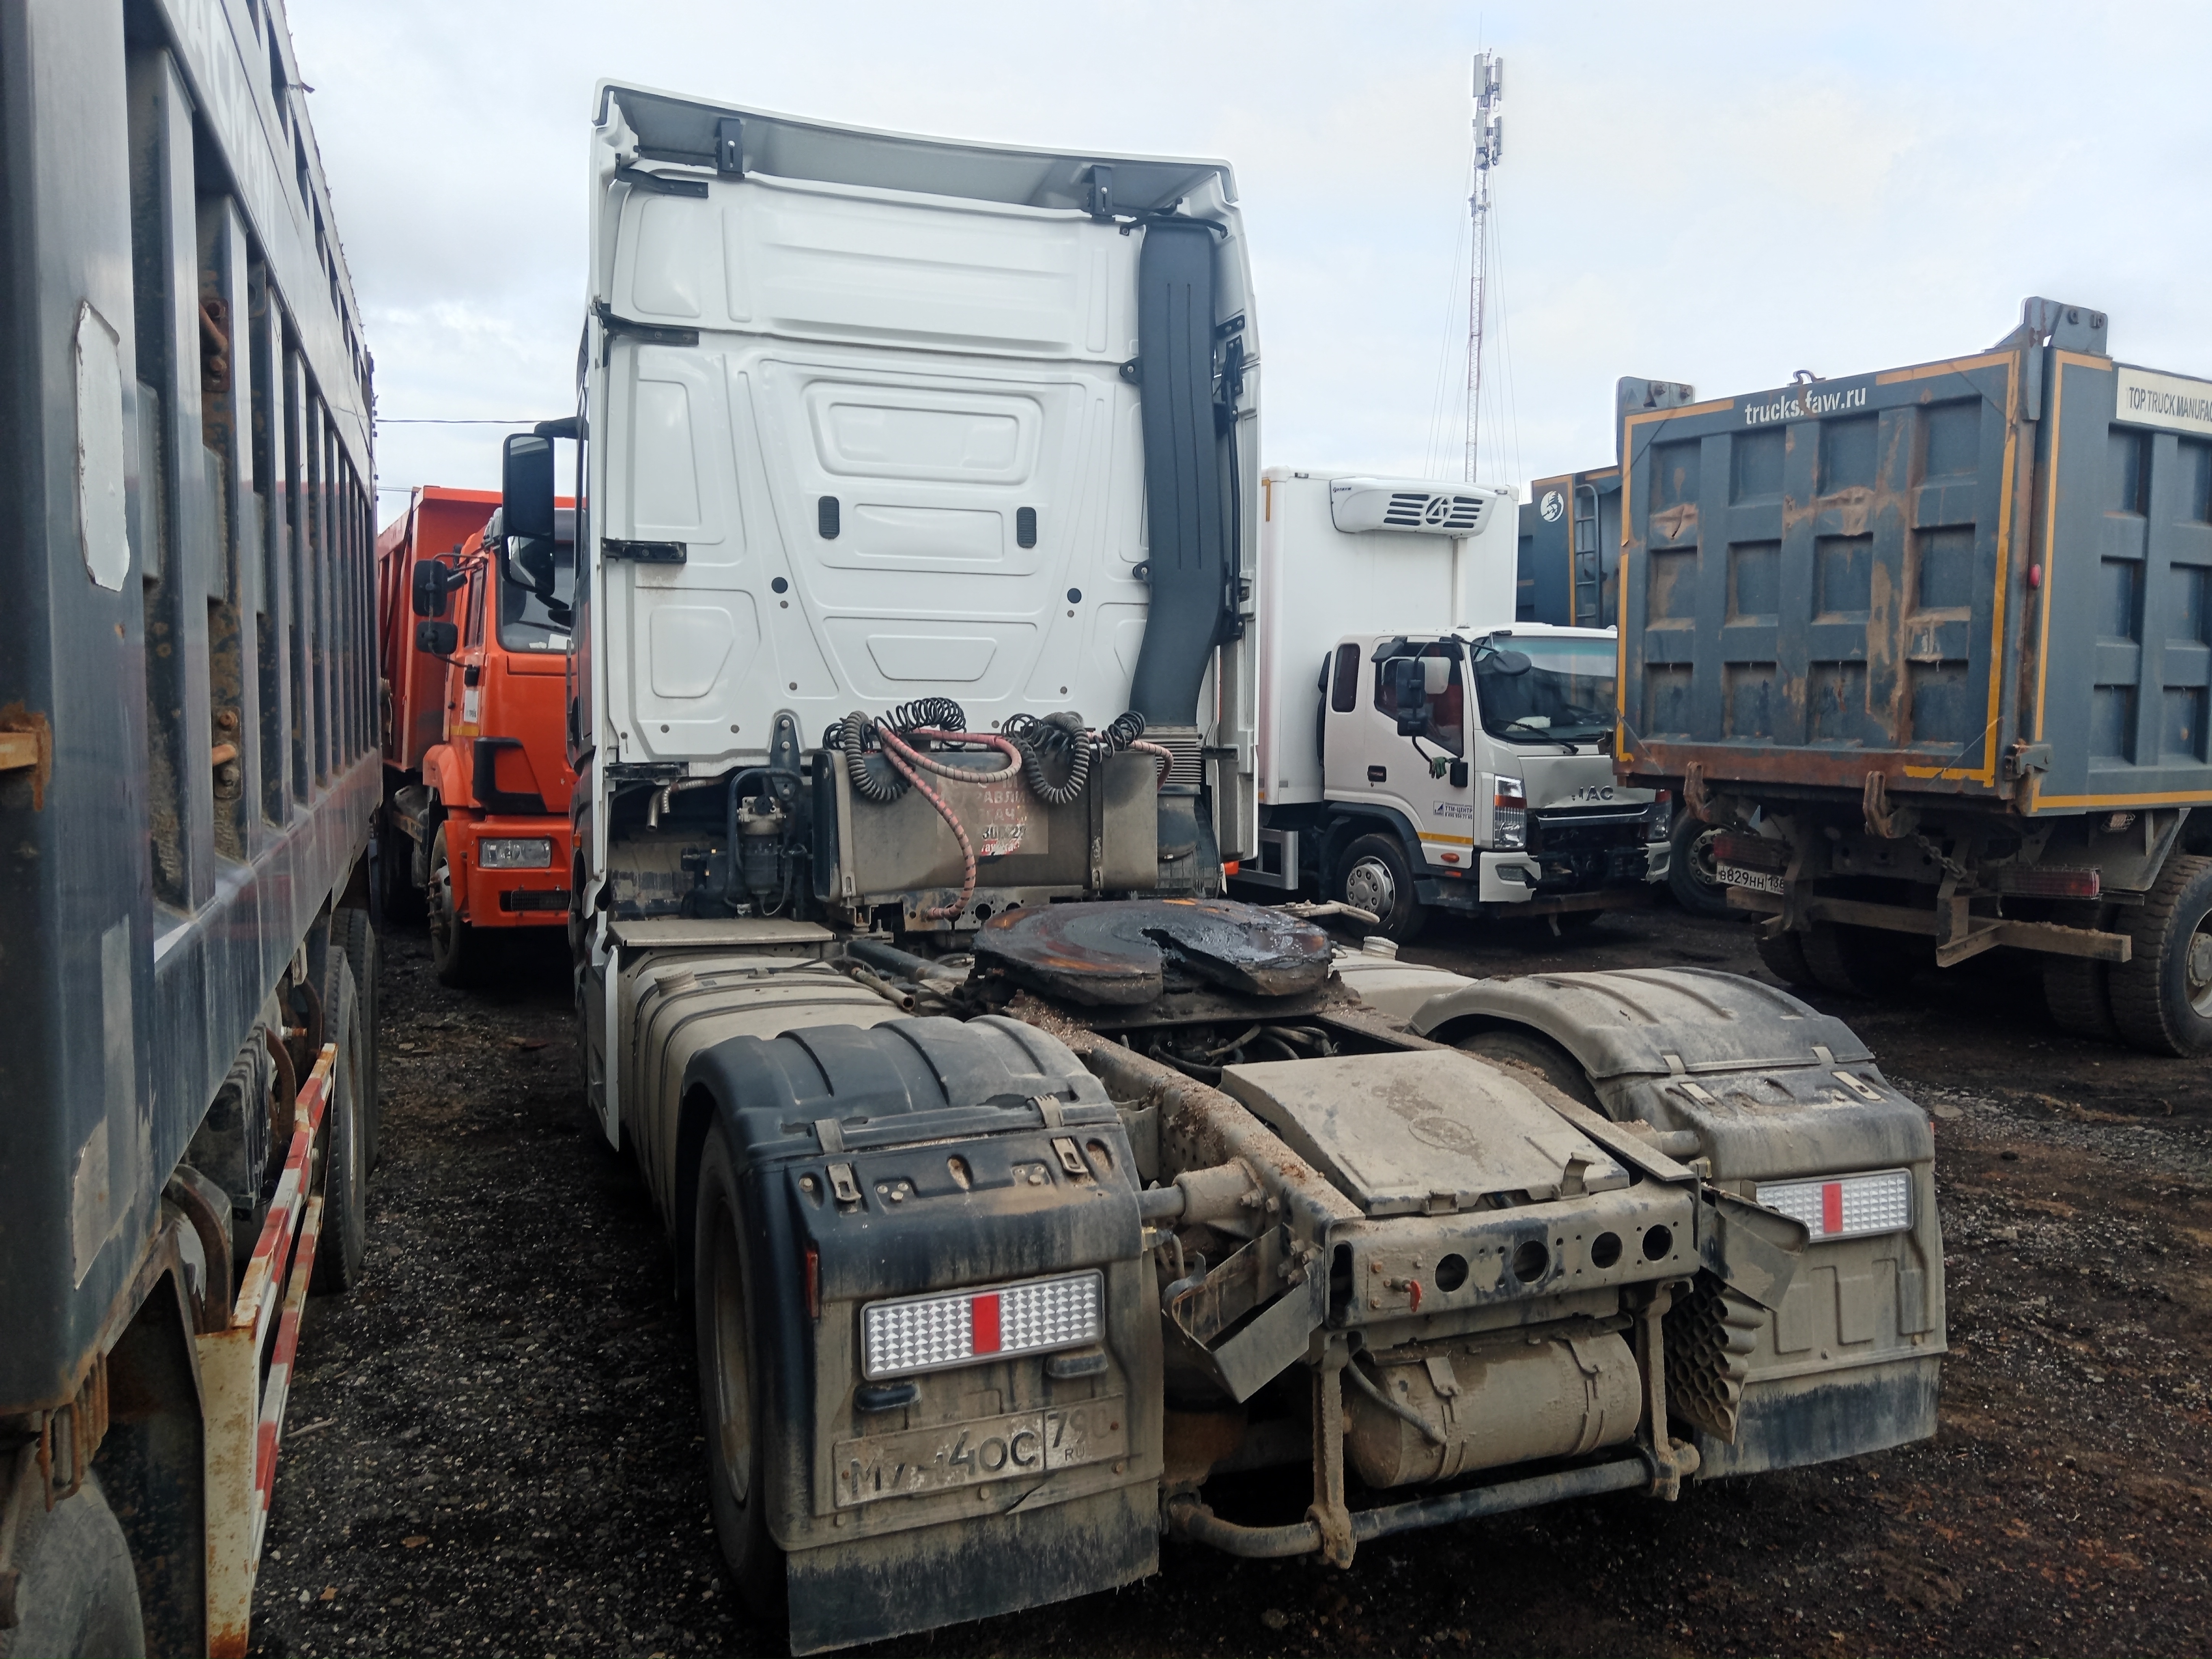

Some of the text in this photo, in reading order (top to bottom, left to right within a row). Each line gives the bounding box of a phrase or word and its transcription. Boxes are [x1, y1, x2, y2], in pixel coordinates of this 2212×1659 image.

[1745, 387, 1866, 425] trucks.faw.ru
[2129, 386, 2146, 410] TOP
[2147, 390, 2176, 416] TRUCK
